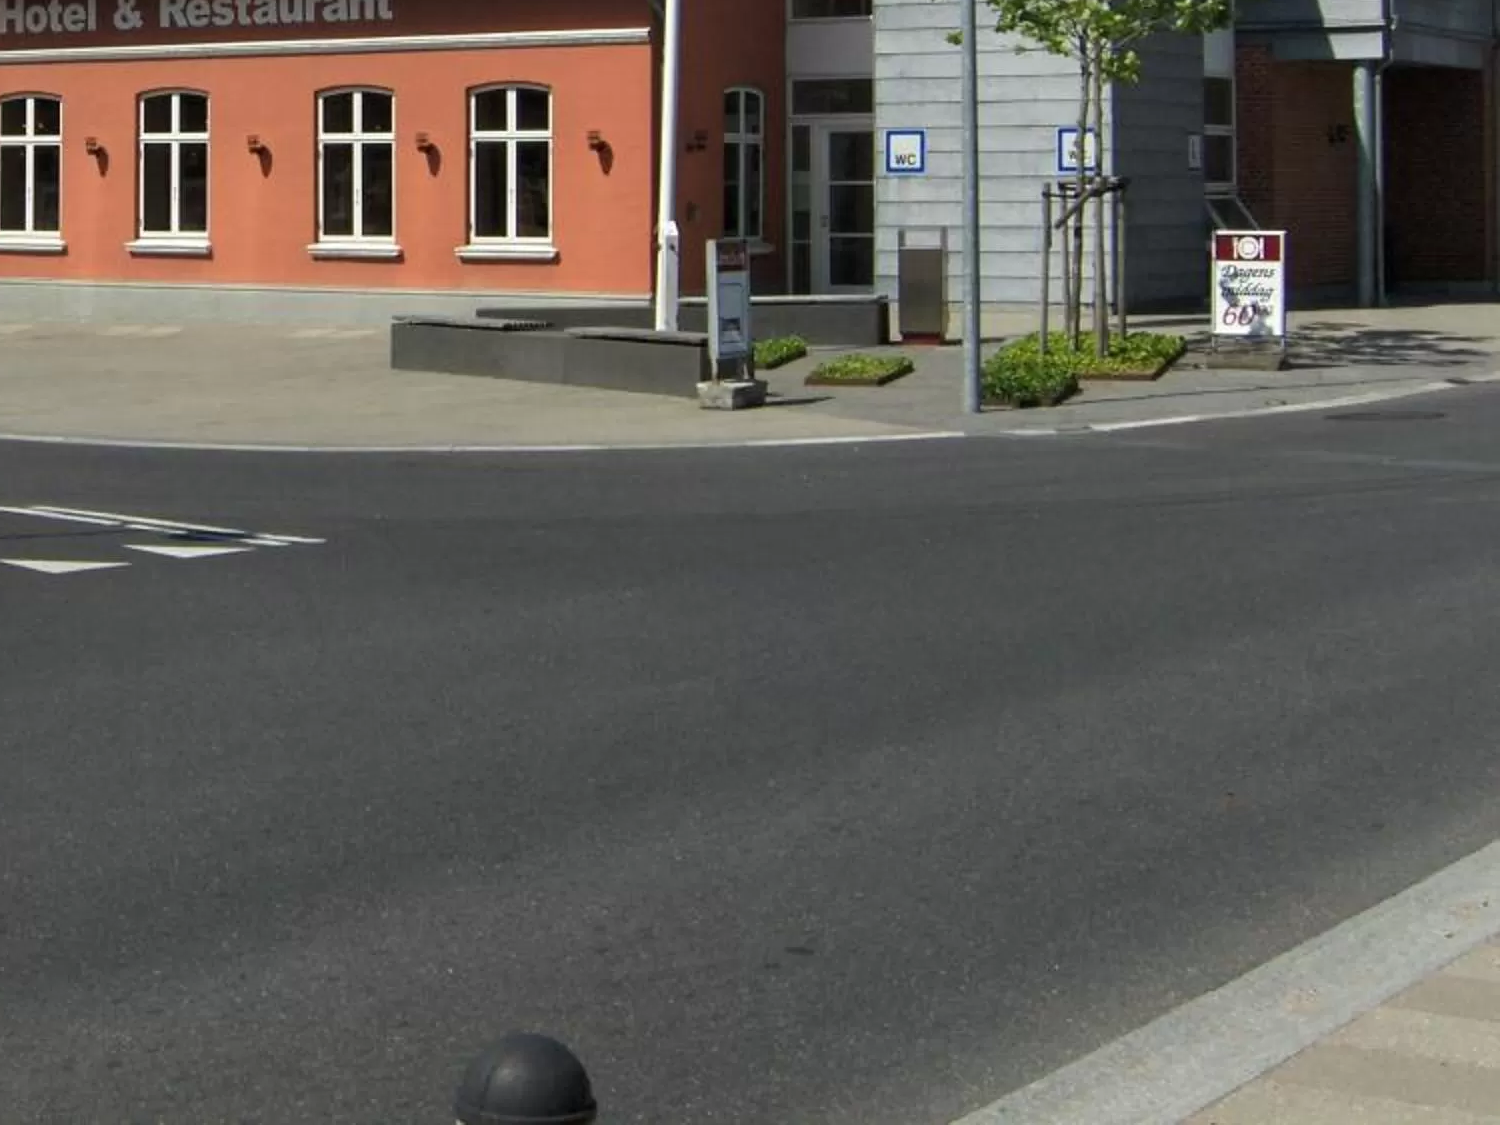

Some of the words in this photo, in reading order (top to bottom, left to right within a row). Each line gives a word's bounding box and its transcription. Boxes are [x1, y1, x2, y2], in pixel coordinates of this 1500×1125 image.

[894, 153, 917, 166] WC
[1220, 264, 1276, 283] Dagens
[1222, 303, 1257, 326] 60
